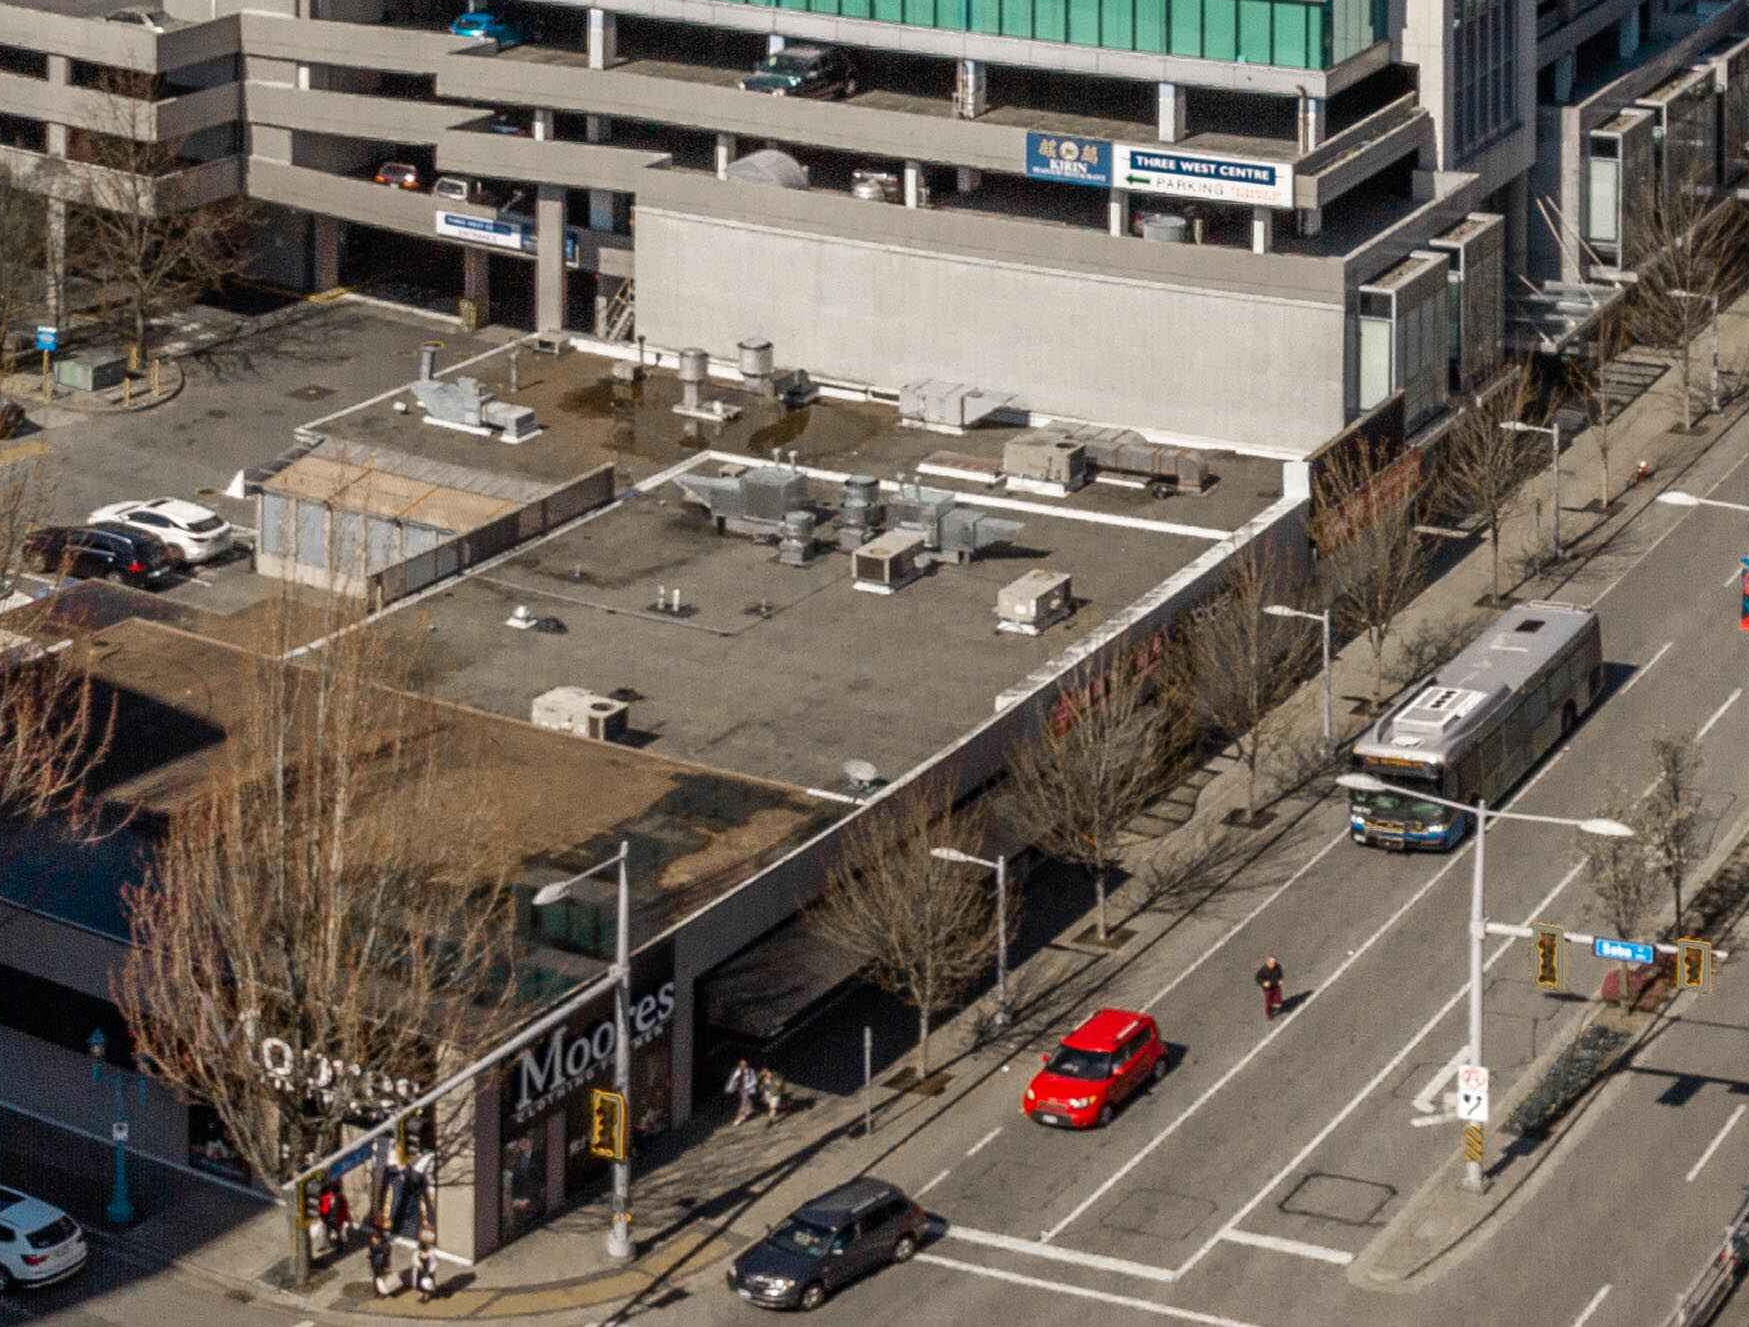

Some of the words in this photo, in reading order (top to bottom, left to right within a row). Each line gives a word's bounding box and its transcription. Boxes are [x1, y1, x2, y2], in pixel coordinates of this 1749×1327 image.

[1135, 154, 1178, 171] THREE
[1179, 160, 1217, 175] WEST
[1219, 164, 1271, 181] CENTRE
[1155, 178, 1225, 196] PARKING
[516, 981, 675, 1110] Mooes
